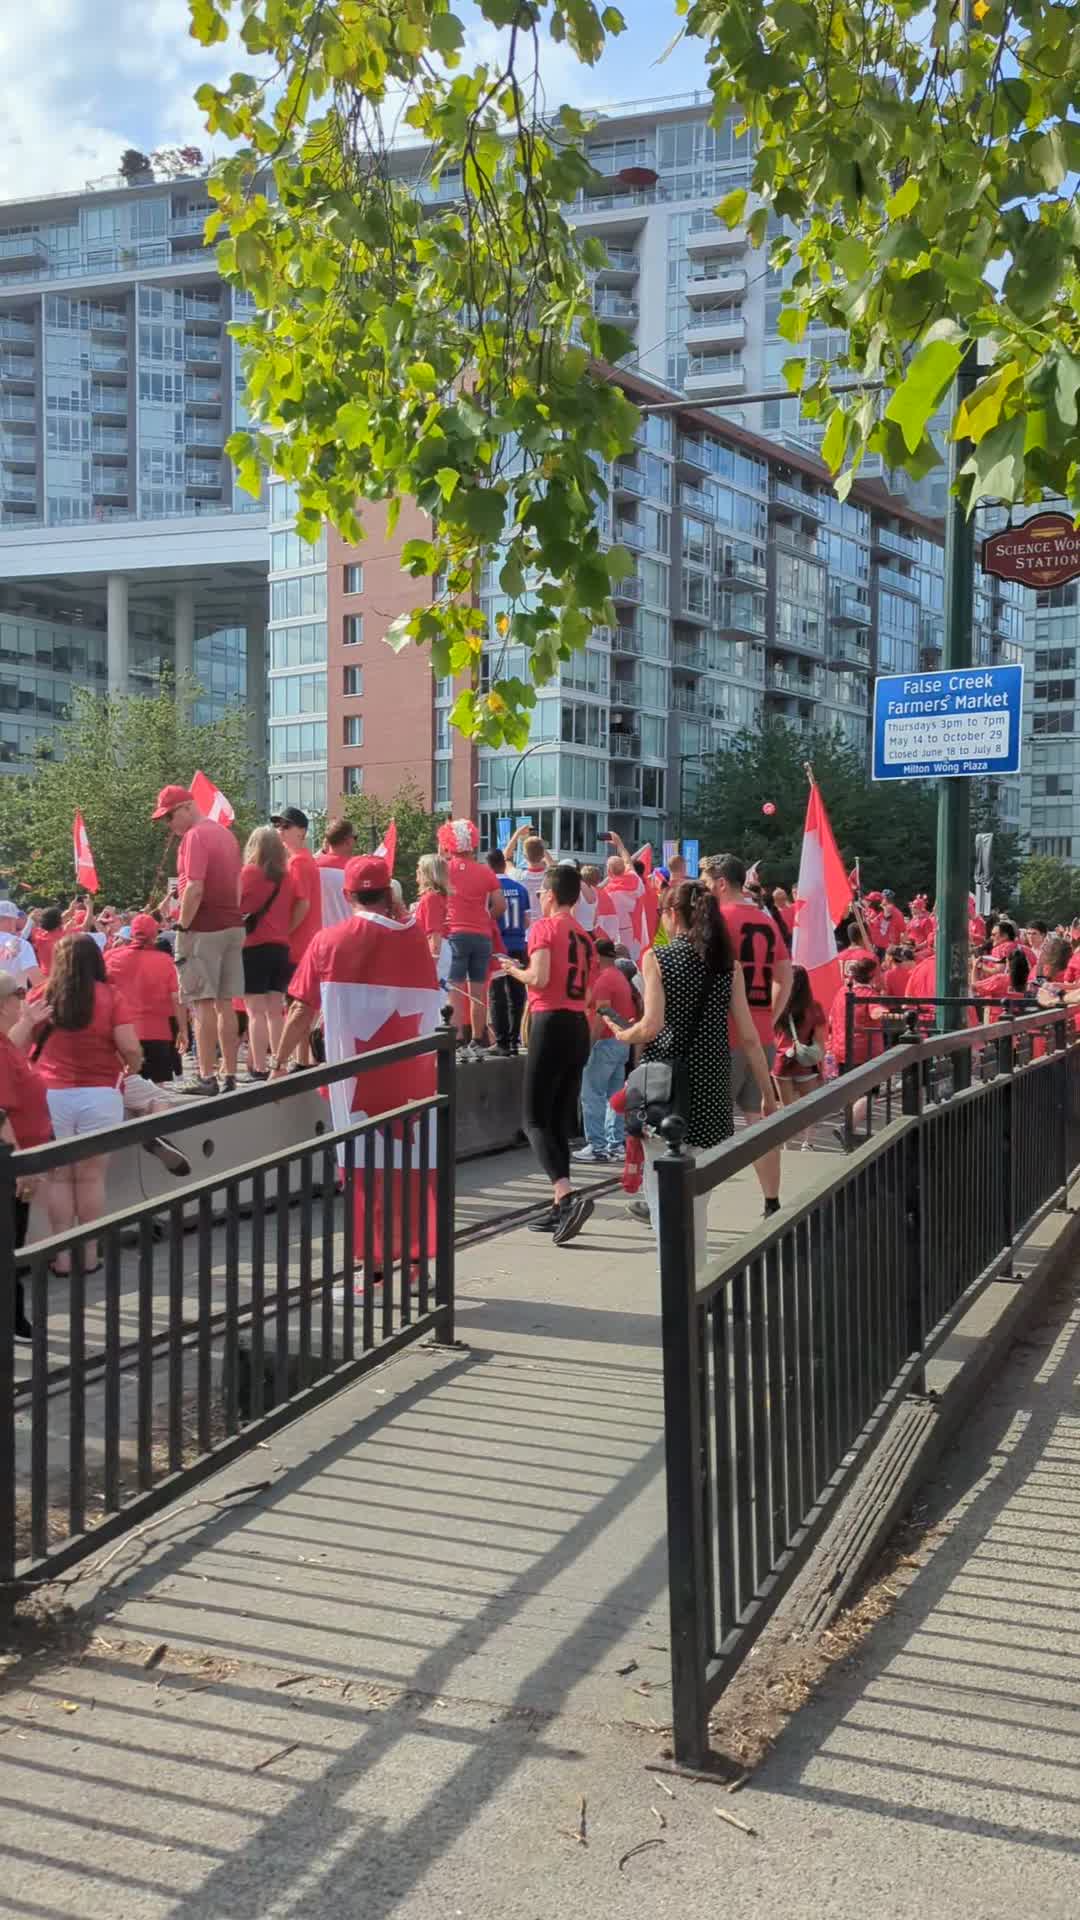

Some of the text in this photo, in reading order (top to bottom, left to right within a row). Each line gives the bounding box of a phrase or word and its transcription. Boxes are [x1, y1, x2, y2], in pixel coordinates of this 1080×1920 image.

[996, 542, 1050, 557] SCIENCE
[1015, 554, 1079, 569] STATION
[903, 673, 993, 695] False Creek
[955, 692, 1009, 709] Market
[888, 716, 1005, 732] Thursdays 3pm to 7pm
[890, 730, 1003, 747] May 14 to October 29
[889, 744, 1002, 759] Closed June 18 to July 8
[903, 761, 989, 774] Milton Wong Plaza
